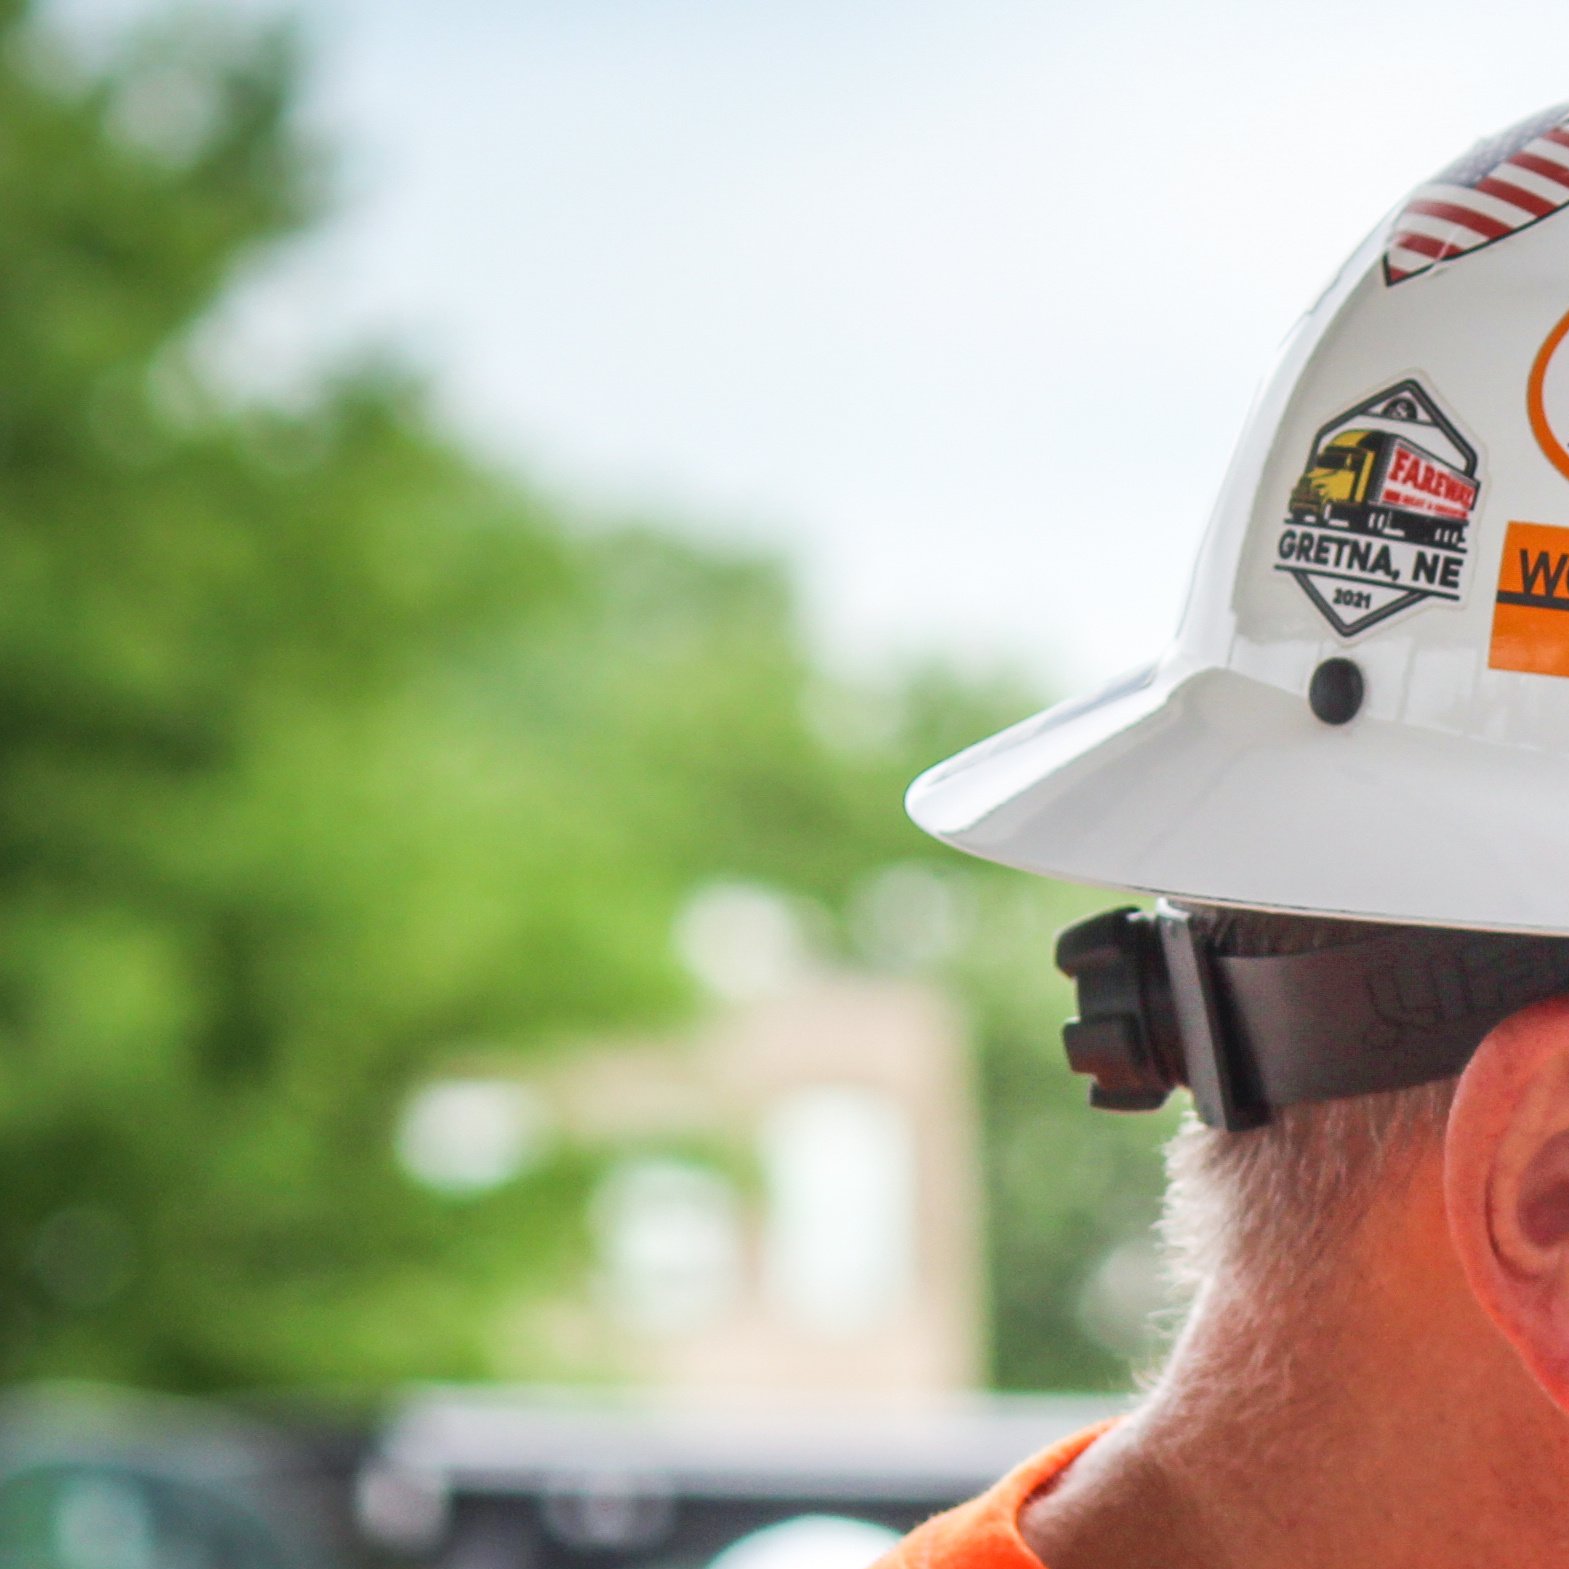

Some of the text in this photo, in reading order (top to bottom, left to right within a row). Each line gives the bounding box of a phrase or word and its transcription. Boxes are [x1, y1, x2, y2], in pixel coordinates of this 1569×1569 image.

[1278, 529, 1464, 589] GRETNA, NE
[1333, 588, 1372, 609] 2021
